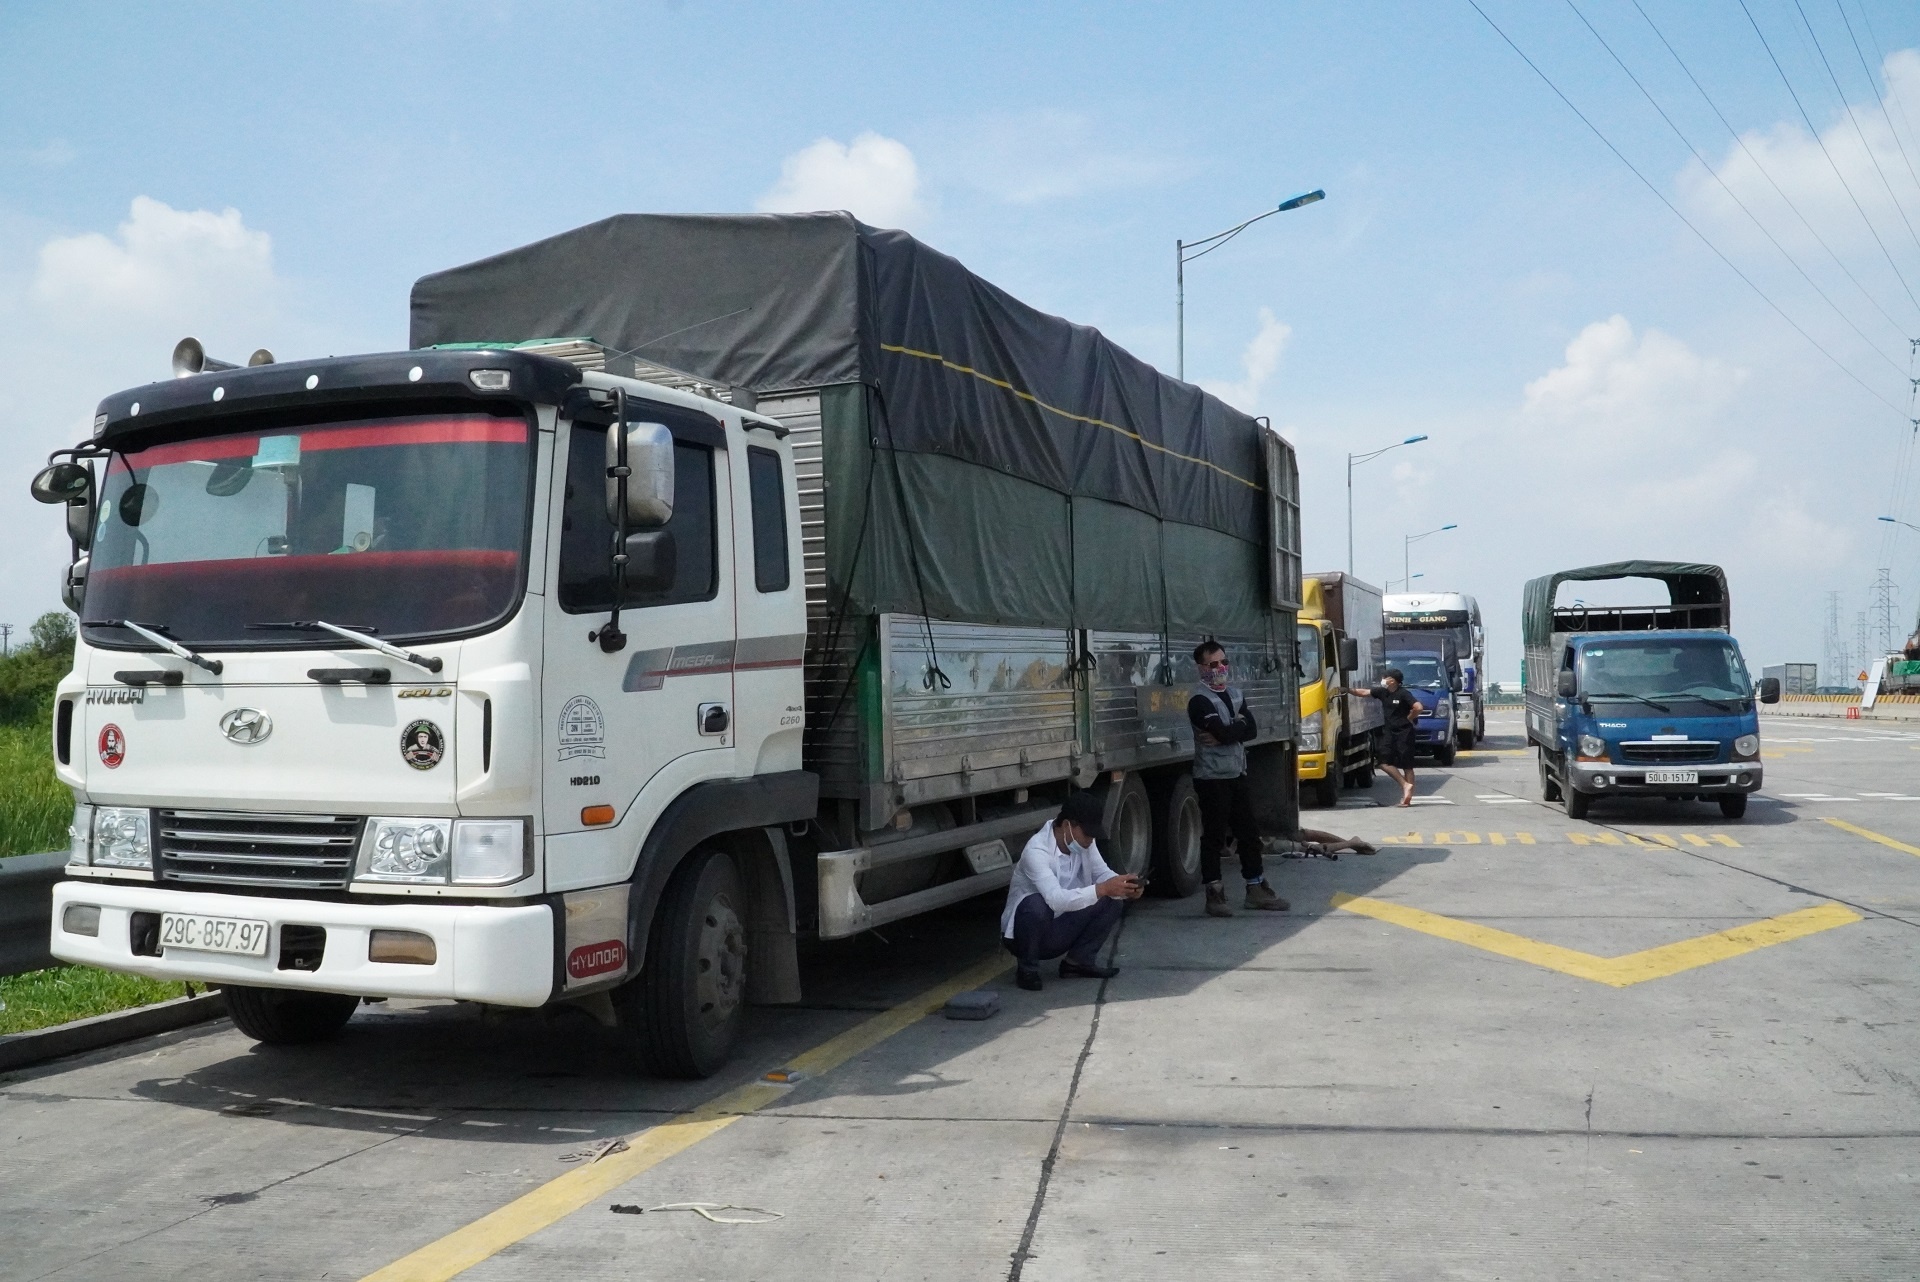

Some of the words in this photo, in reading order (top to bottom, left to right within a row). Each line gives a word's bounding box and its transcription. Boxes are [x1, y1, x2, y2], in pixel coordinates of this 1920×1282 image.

[1419, 615, 1448, 623] GIANG
[672, 654, 715, 669] MEGA
[86, 688, 145, 705] HYUNDAI
[397, 687, 453, 698] GOLD
[570, 775, 601, 786] HD210
[163, 917, 264, 951] 29C-857.97
[571, 946, 623, 971] HYUNDAI
